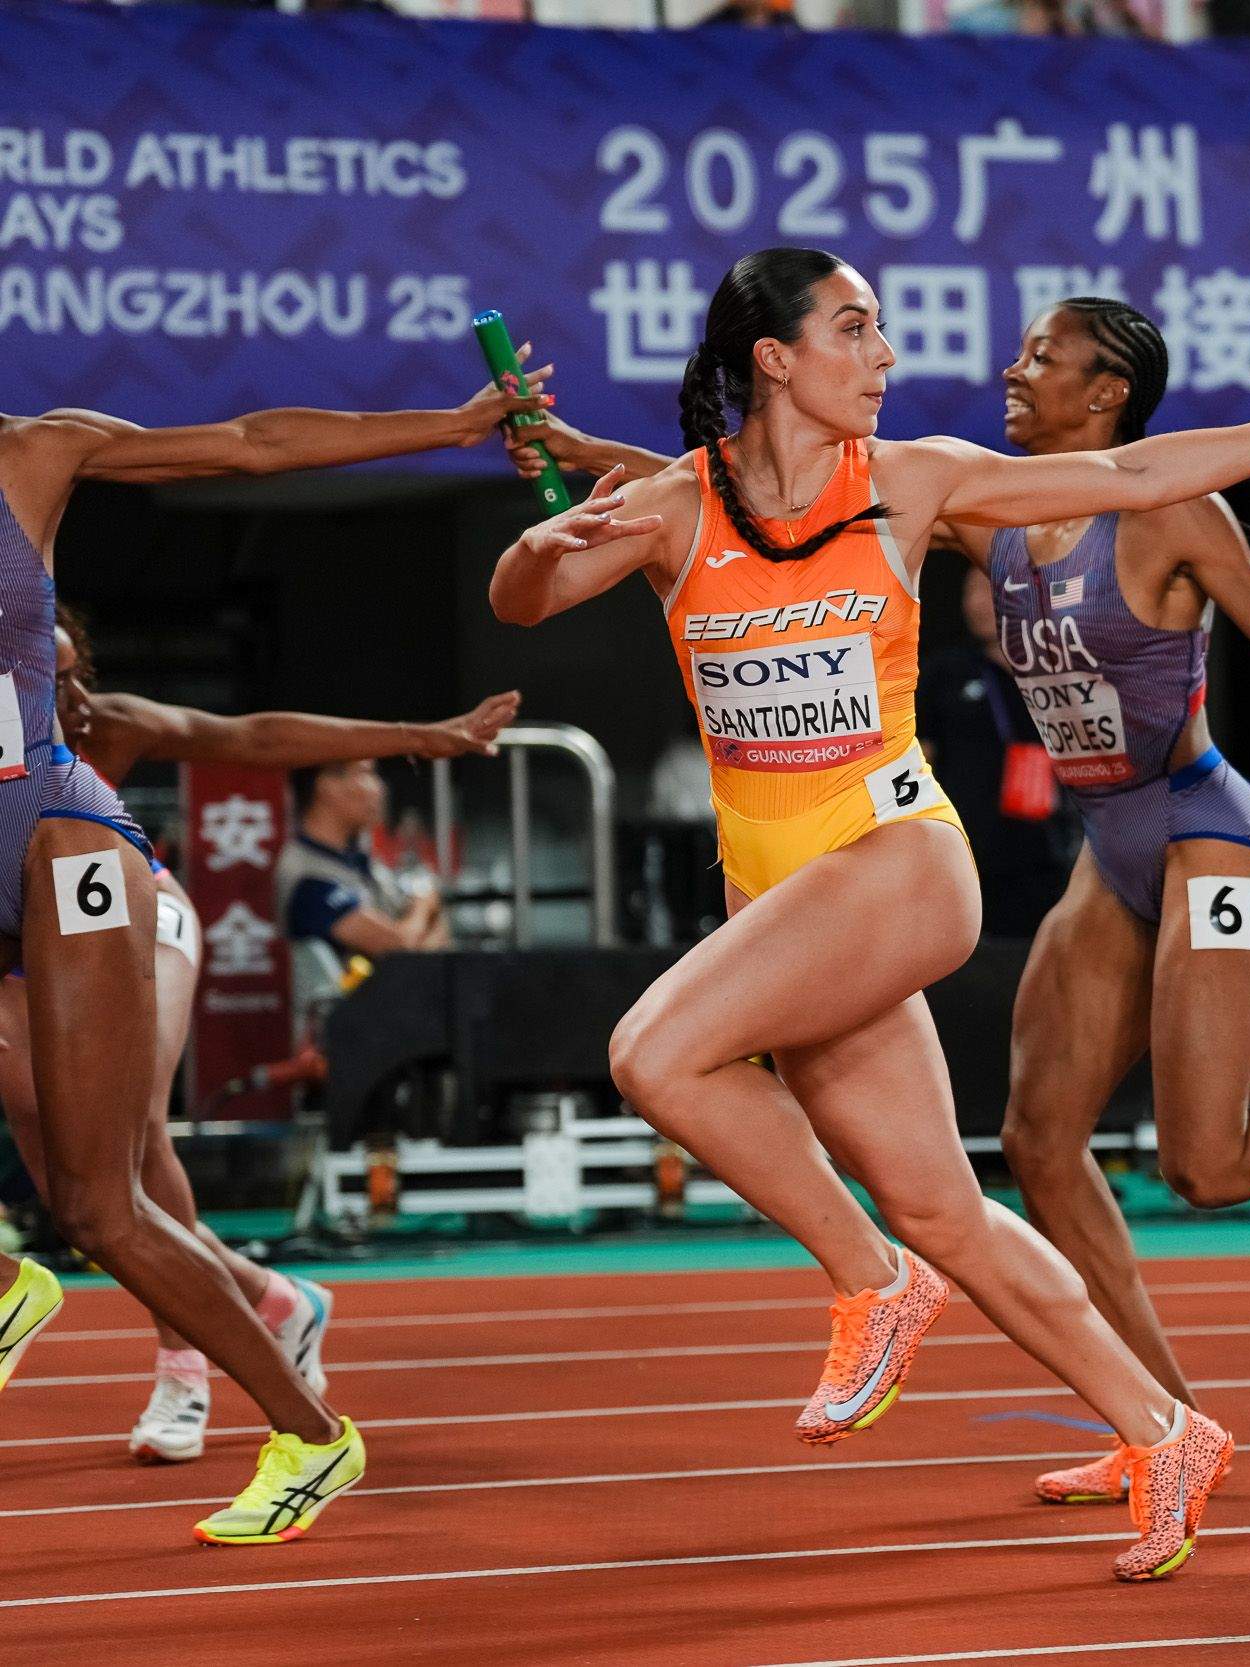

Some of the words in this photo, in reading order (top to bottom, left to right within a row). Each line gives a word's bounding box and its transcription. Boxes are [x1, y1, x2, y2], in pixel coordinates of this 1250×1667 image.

[125, 132, 467, 198] ATHLETICS
[597, 119, 1201, 246] 2025广州
[387, 274, 471, 341] 25
[544, 488, 557, 503] 6
[684, 588, 888, 640] ESPAÑA
[698, 647, 851, 688] SONY
[1001, 615, 1099, 673] USA
[704, 688, 872, 738] SANTIDRIÁN
[1037, 715, 1117, 753] OPLES
[746, 744, 851, 764] GUANGZHOU
[891, 769, 919, 808] 5
[77, 862, 112, 917] 6
[200, 795, 274, 977] 安全
[1209, 885, 1243, 935] 6
